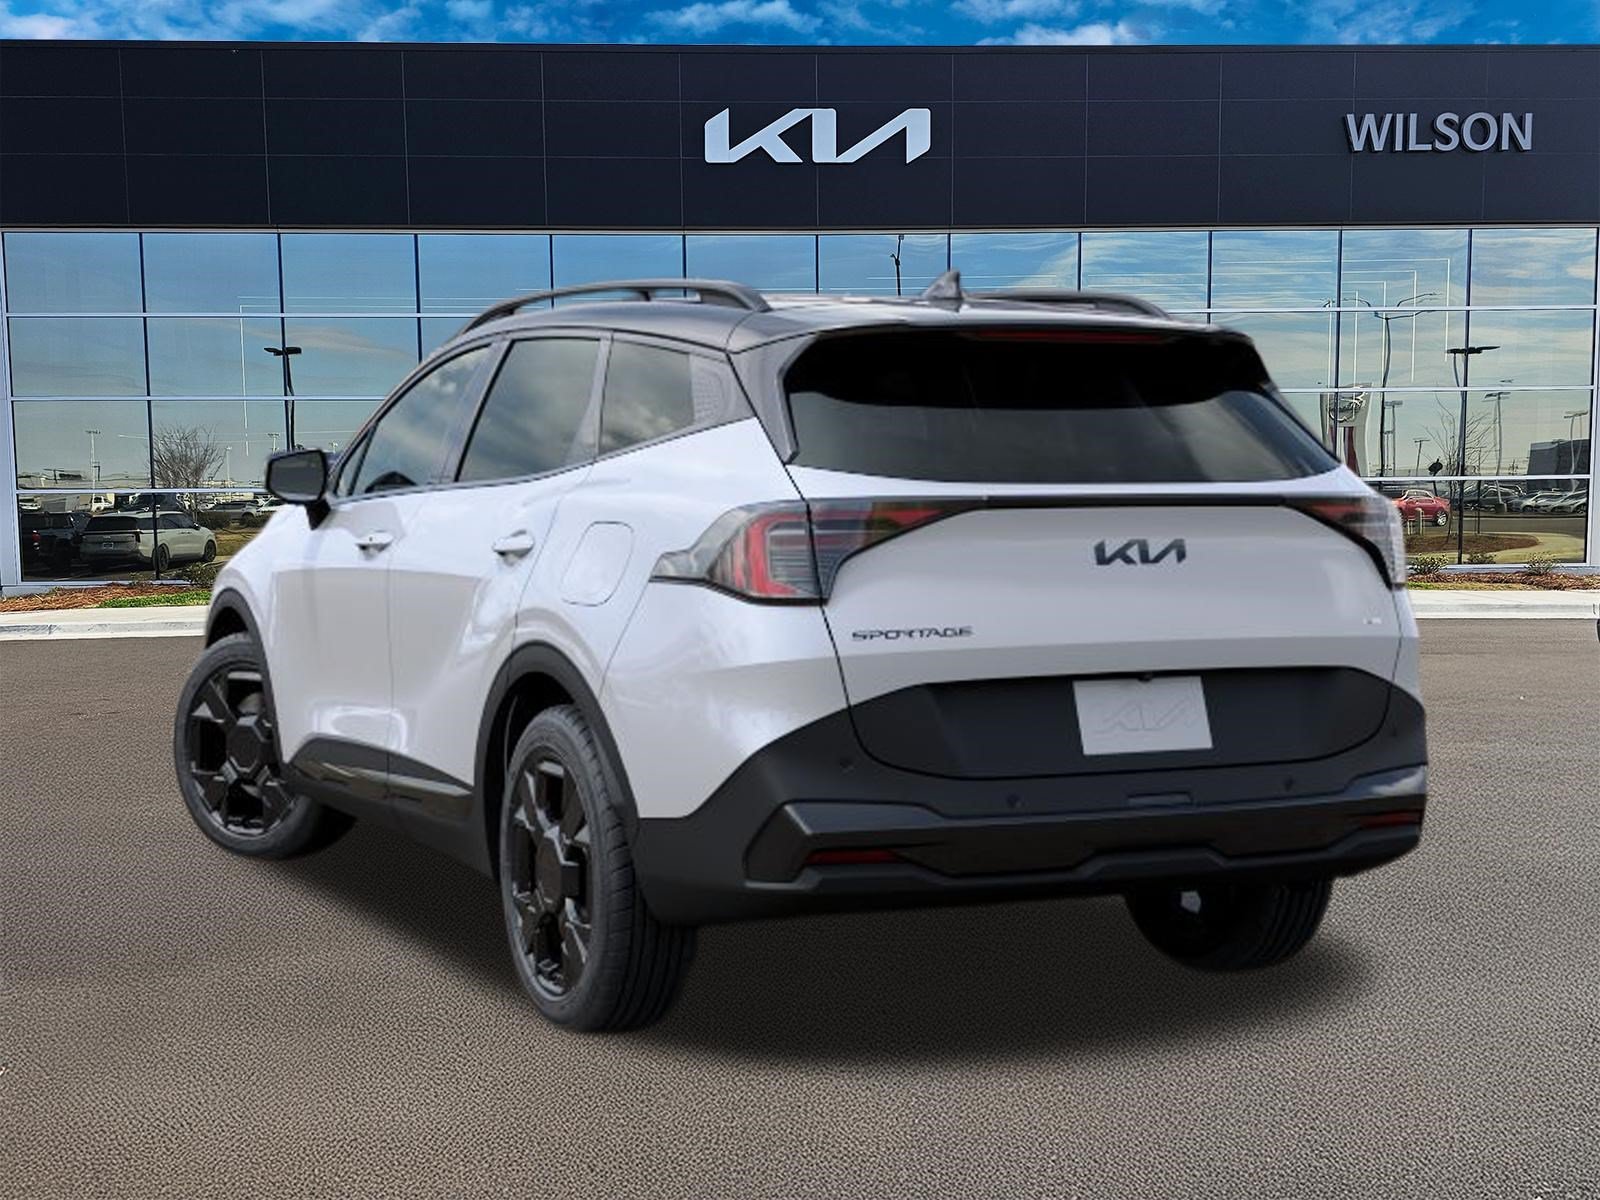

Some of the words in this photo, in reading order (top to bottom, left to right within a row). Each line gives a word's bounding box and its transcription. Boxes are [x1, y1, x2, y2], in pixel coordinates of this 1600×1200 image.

[704, 107, 931, 164] KIA
[1344, 111, 1534, 152] WILSON
[1094, 538, 1186, 566] KIA
[852, 625, 974, 640] SPORTAGE
